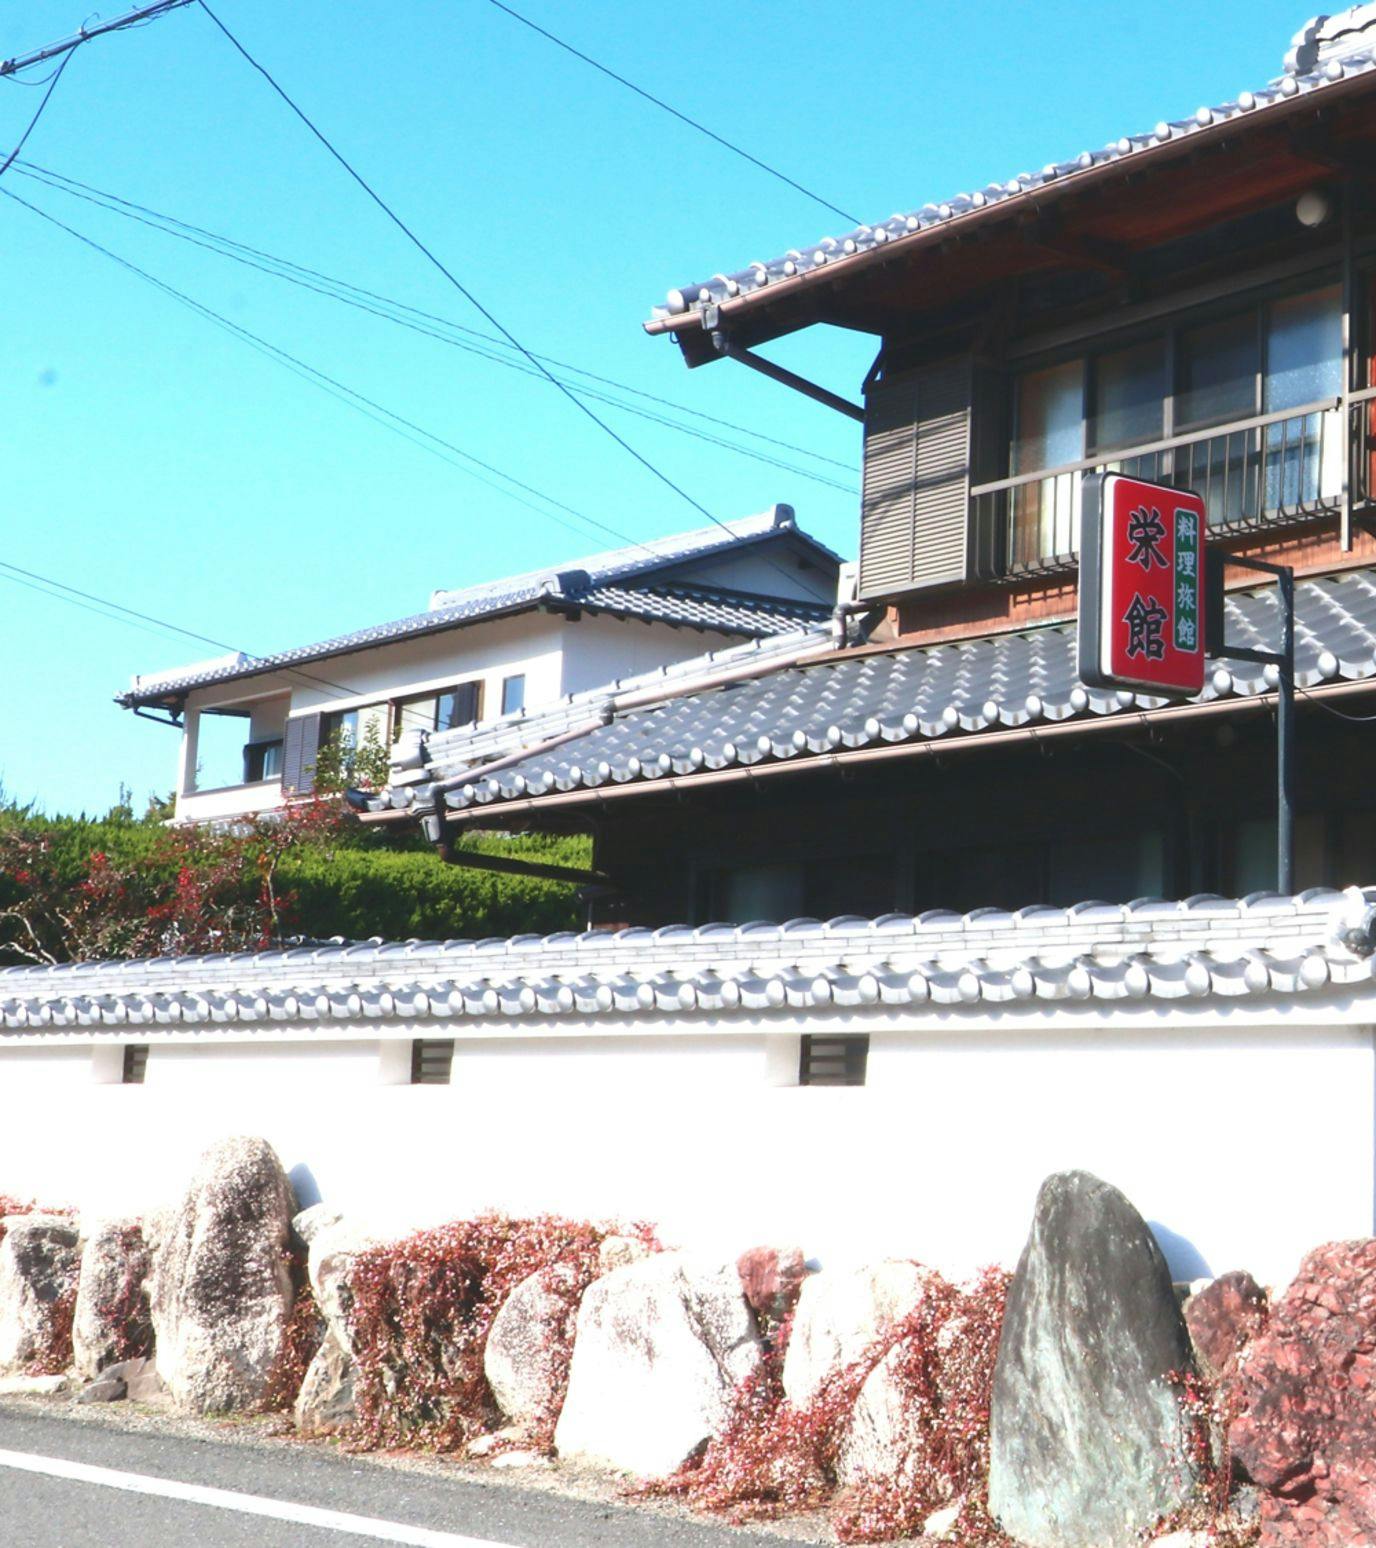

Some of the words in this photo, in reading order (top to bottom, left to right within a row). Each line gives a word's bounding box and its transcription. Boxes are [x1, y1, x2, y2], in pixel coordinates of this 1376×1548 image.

[1122, 505, 1169, 660] 栄館
[1177, 515, 1197, 647] 料理旅館
